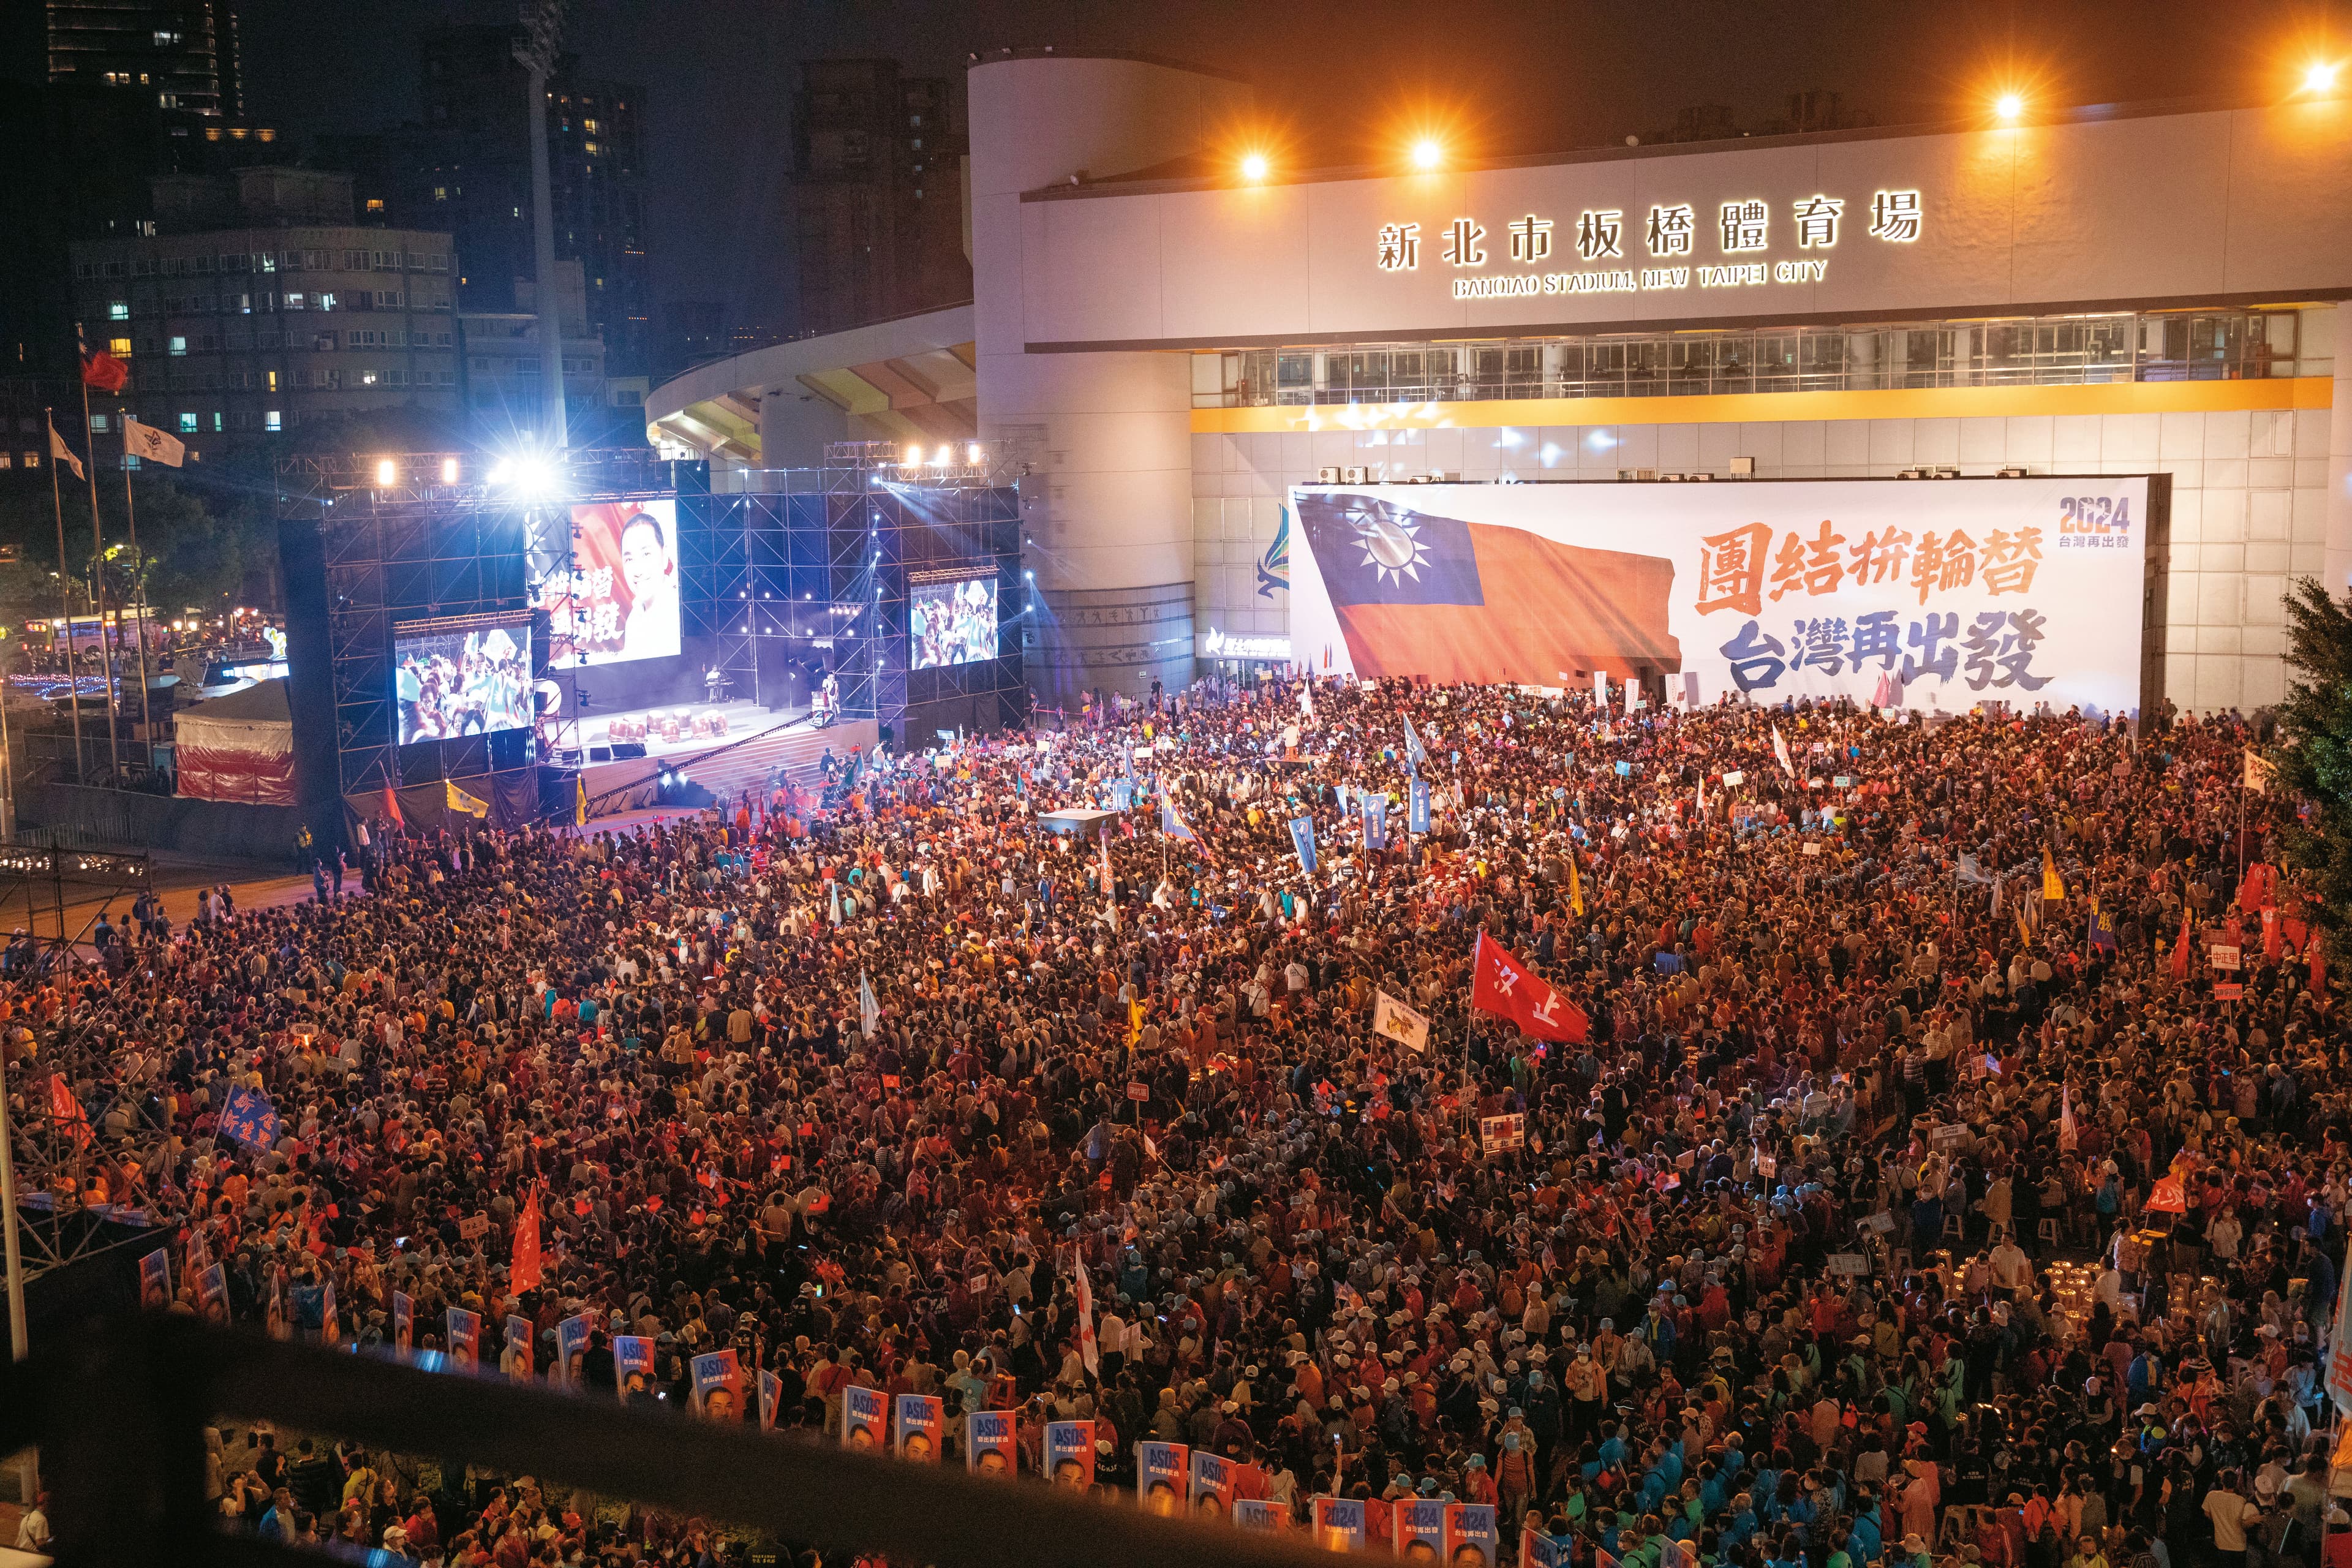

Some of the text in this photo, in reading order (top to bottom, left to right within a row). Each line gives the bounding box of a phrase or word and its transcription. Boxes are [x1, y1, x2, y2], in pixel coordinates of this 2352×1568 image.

[1379, 190, 1922, 270] 新北市板橋體育場
[1453, 260, 1828, 298] BANQIAO STADIUM, NEW TAIPEI CITY
[2060, 497, 2130, 533] 2024
[2059, 535, 2130, 548] 台灣再出發
[1719, 608, 2056, 692] 台灣再出發
[2213, 951, 2239, 965] 中正里
[1494, 959, 1561, 1028] 汐止
[223, 1109, 271, 1149] 新生里
[234, 1093, 277, 1130] 新店
[1484, 1138, 1523, 1149] 江北里
[1324, 1505, 1357, 1527] 2024
[1404, 1507, 1438, 1527] 2024
[1453, 1510, 1488, 1531] 2024
